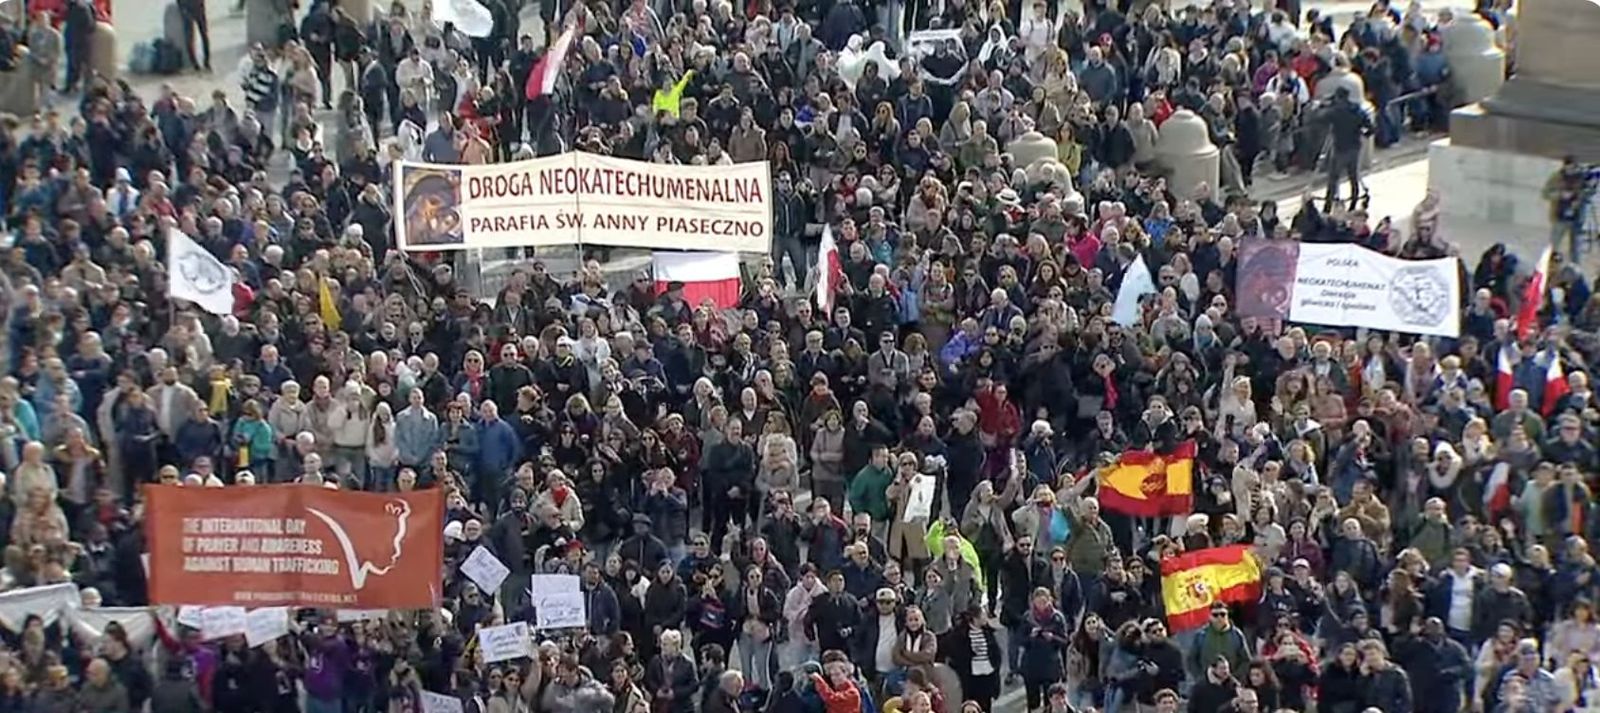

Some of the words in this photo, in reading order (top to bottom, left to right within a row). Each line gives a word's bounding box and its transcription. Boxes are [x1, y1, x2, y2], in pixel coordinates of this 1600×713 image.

[469, 172, 533, 199] DROGA
[540, 167, 763, 203] NEOKATECHUMENALNA
[471, 214, 550, 233] PARAFIA
[556, 208, 587, 229] ŚW.
[593, 213, 649, 231] ANNY
[656, 216, 764, 237] PIASECZNO
[1326, 258, 1358, 267] POLSKA
[202, 518, 283, 535] INTERNATIONAL
[286, 519, 306, 535] DAY
[183, 537, 195, 553] OF
[197, 537, 239, 553] PRAYER
[240, 538, 259, 553] AND
[261, 538, 323, 555] AWARENESS
[184, 556, 230, 572] AGAINST
[232, 557, 271, 573] HUMAN
[272, 557, 339, 575] TRAFFICKING
